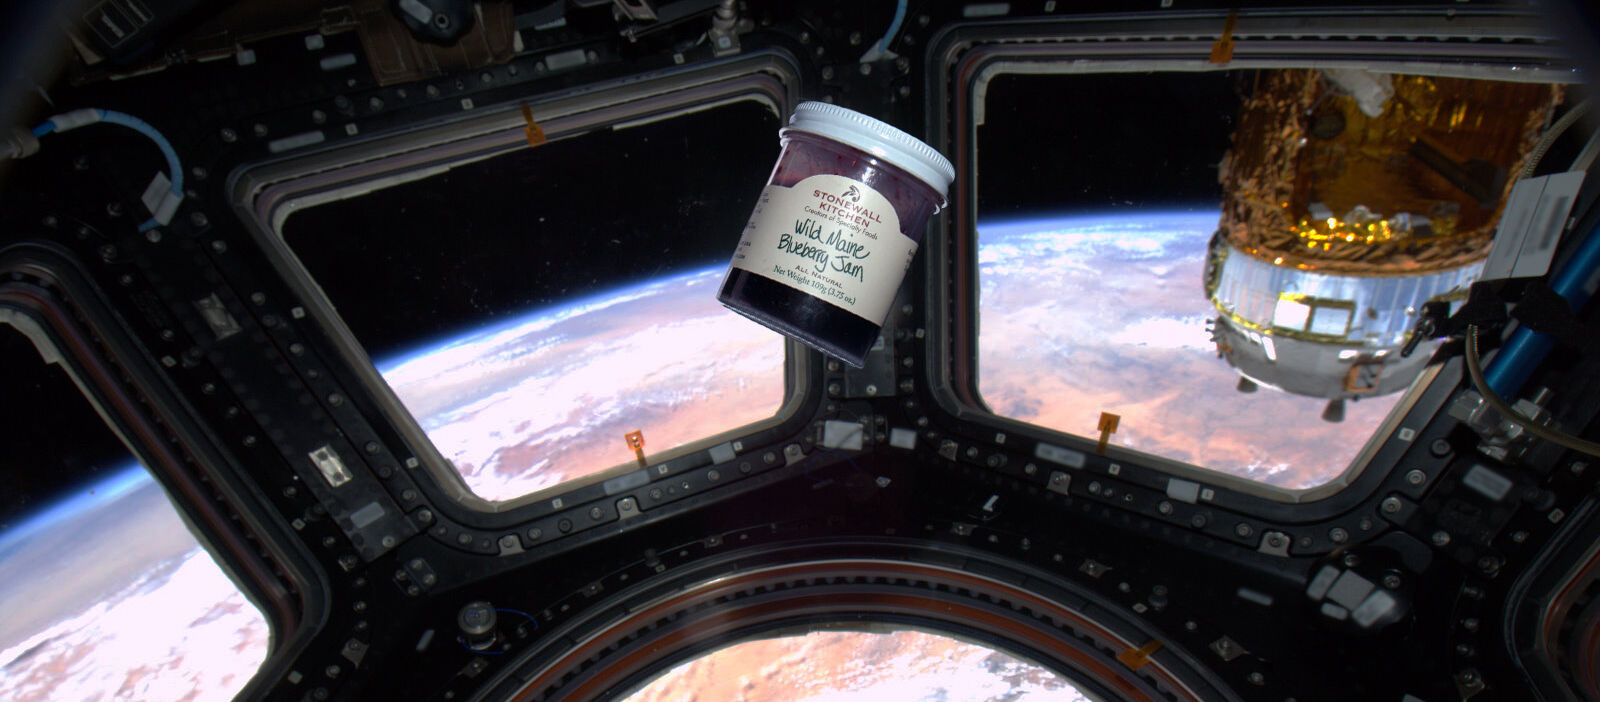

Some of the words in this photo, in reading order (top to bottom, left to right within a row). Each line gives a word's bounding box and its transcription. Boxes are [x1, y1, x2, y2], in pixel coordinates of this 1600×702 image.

[804, 205, 828, 219] Creators
[836, 217, 861, 233] Specialty
[862, 228, 878, 240] Foods
[813, 189, 882, 224] STONEWALL
[820, 201, 870, 228] KITCHEN
[794, 217, 824, 244] Wild
[825, 229, 871, 260] Maine
[777, 233, 829, 273] Blueberry
[830, 255, 864, 283] Jam
[773, 264, 786, 275] Net
[787, 269, 810, 285] Weight
[811, 279, 827, 295] 109g
[794, 265, 809, 275] ALL
[811, 270, 843, 289] NATURAL
